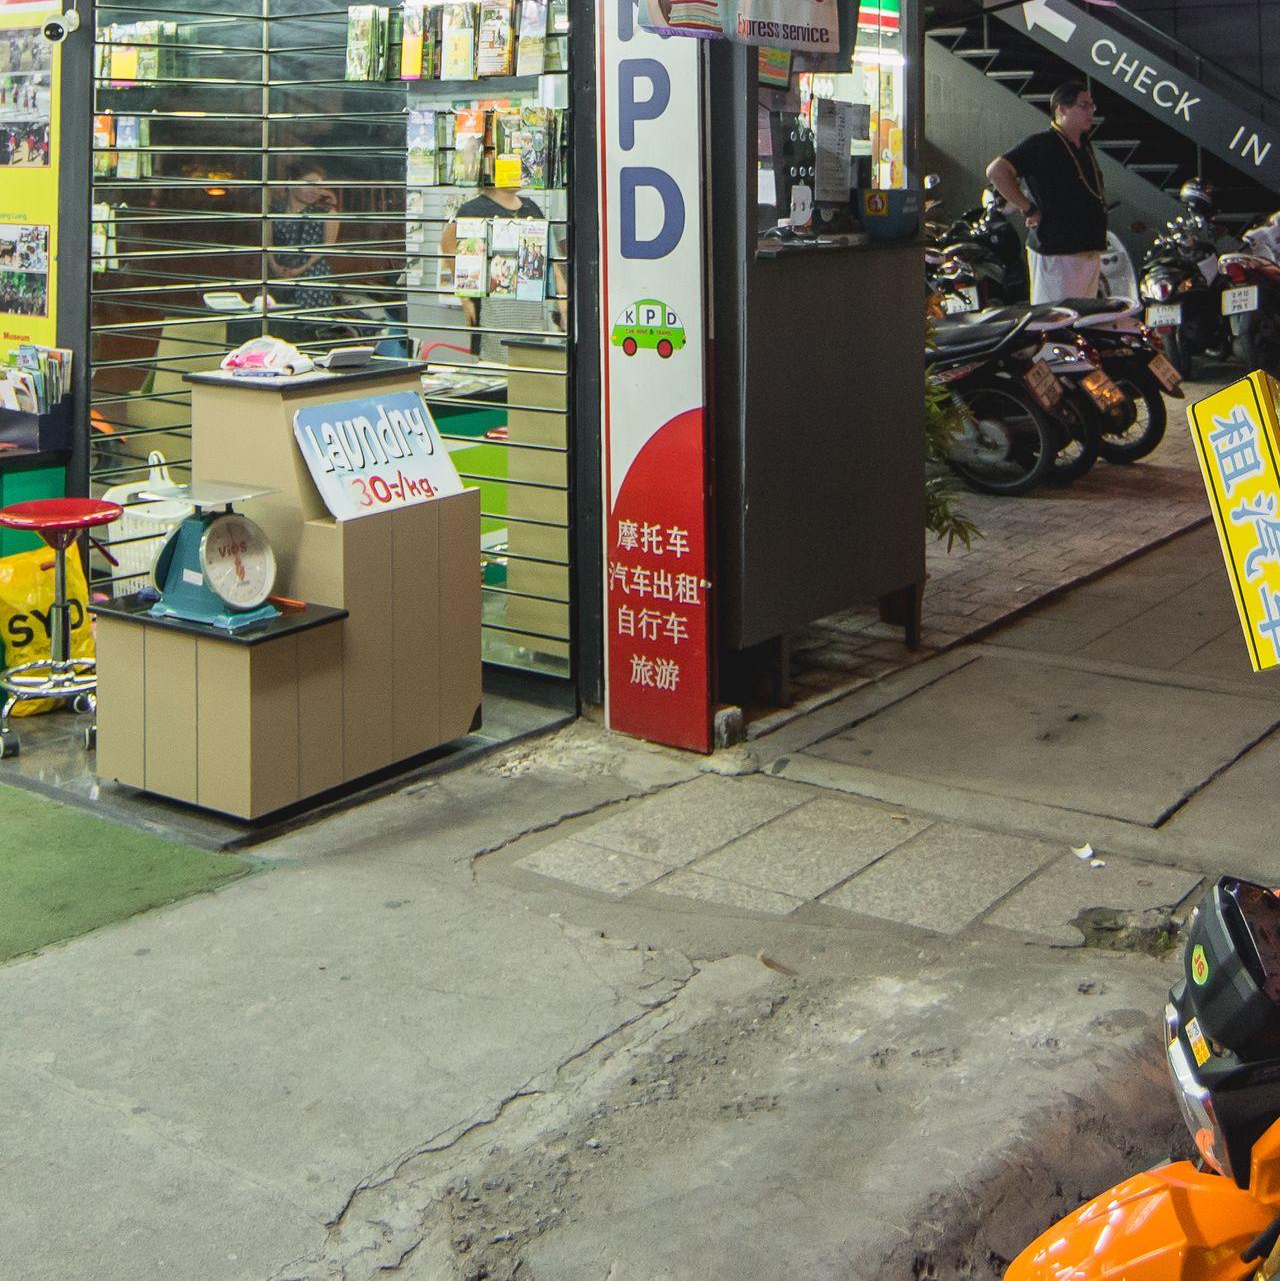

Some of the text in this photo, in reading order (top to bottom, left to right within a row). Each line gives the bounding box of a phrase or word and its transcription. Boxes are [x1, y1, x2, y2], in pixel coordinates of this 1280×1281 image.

[737, 13, 829, 43] Express service
[1090, 38, 1272, 167] CHECK IN
[3, 331, 30, 342] Museum
[625, 310, 677, 325] KPD
[305, 404, 435, 475] Laundry
[617, 519, 691, 558] 摩托车
[608, 560, 701, 605] 汽车出租
[617, 604, 689, 645] 自行车
[630, 655, 680, 692] 旅游
